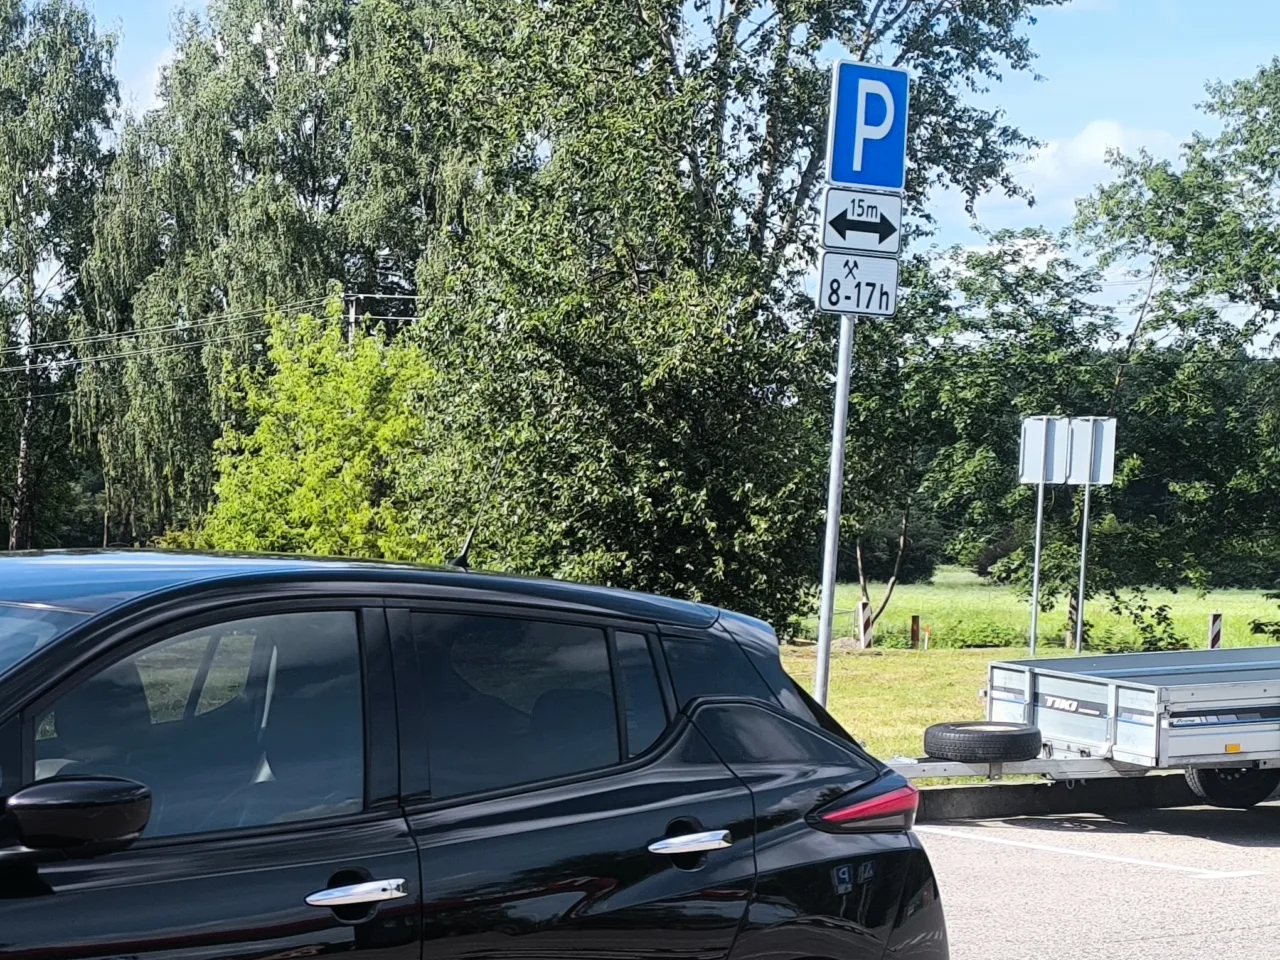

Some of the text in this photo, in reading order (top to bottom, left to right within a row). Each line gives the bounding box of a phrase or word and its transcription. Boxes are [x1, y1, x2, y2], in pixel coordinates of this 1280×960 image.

[852, 78, 895, 172] P
[850, 198, 878, 219] 15m
[1044, 696, 1078, 712] TIKI
